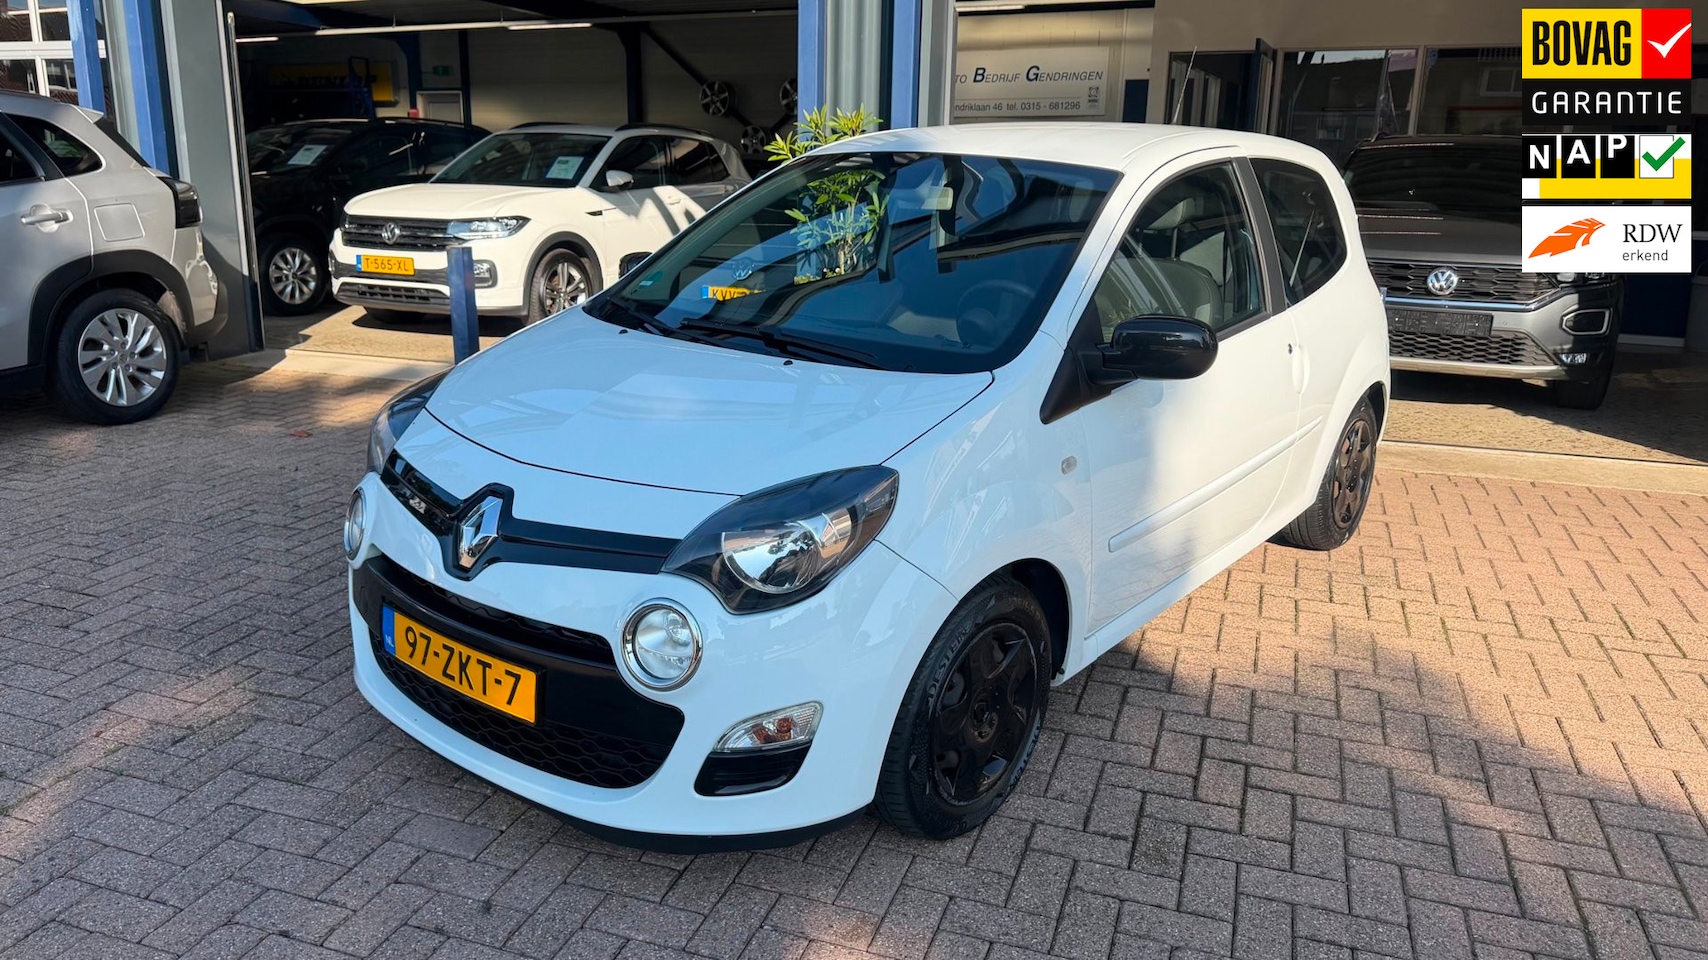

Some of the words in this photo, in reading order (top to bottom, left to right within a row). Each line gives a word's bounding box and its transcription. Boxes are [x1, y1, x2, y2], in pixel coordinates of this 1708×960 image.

[1026, 65, 1104, 82] GENDRINGEN
[993, 102, 1003, 111] 46
[1006, 102, 1018, 111] tel.
[1020, 101, 1041, 110] 0315
[1049, 101, 1080, 111] 681296
[365, 257, 410, 272] T-565-XL
[385, 634, 395, 648] NL
[405, 625, 522, 706] 97-ZKT-7
